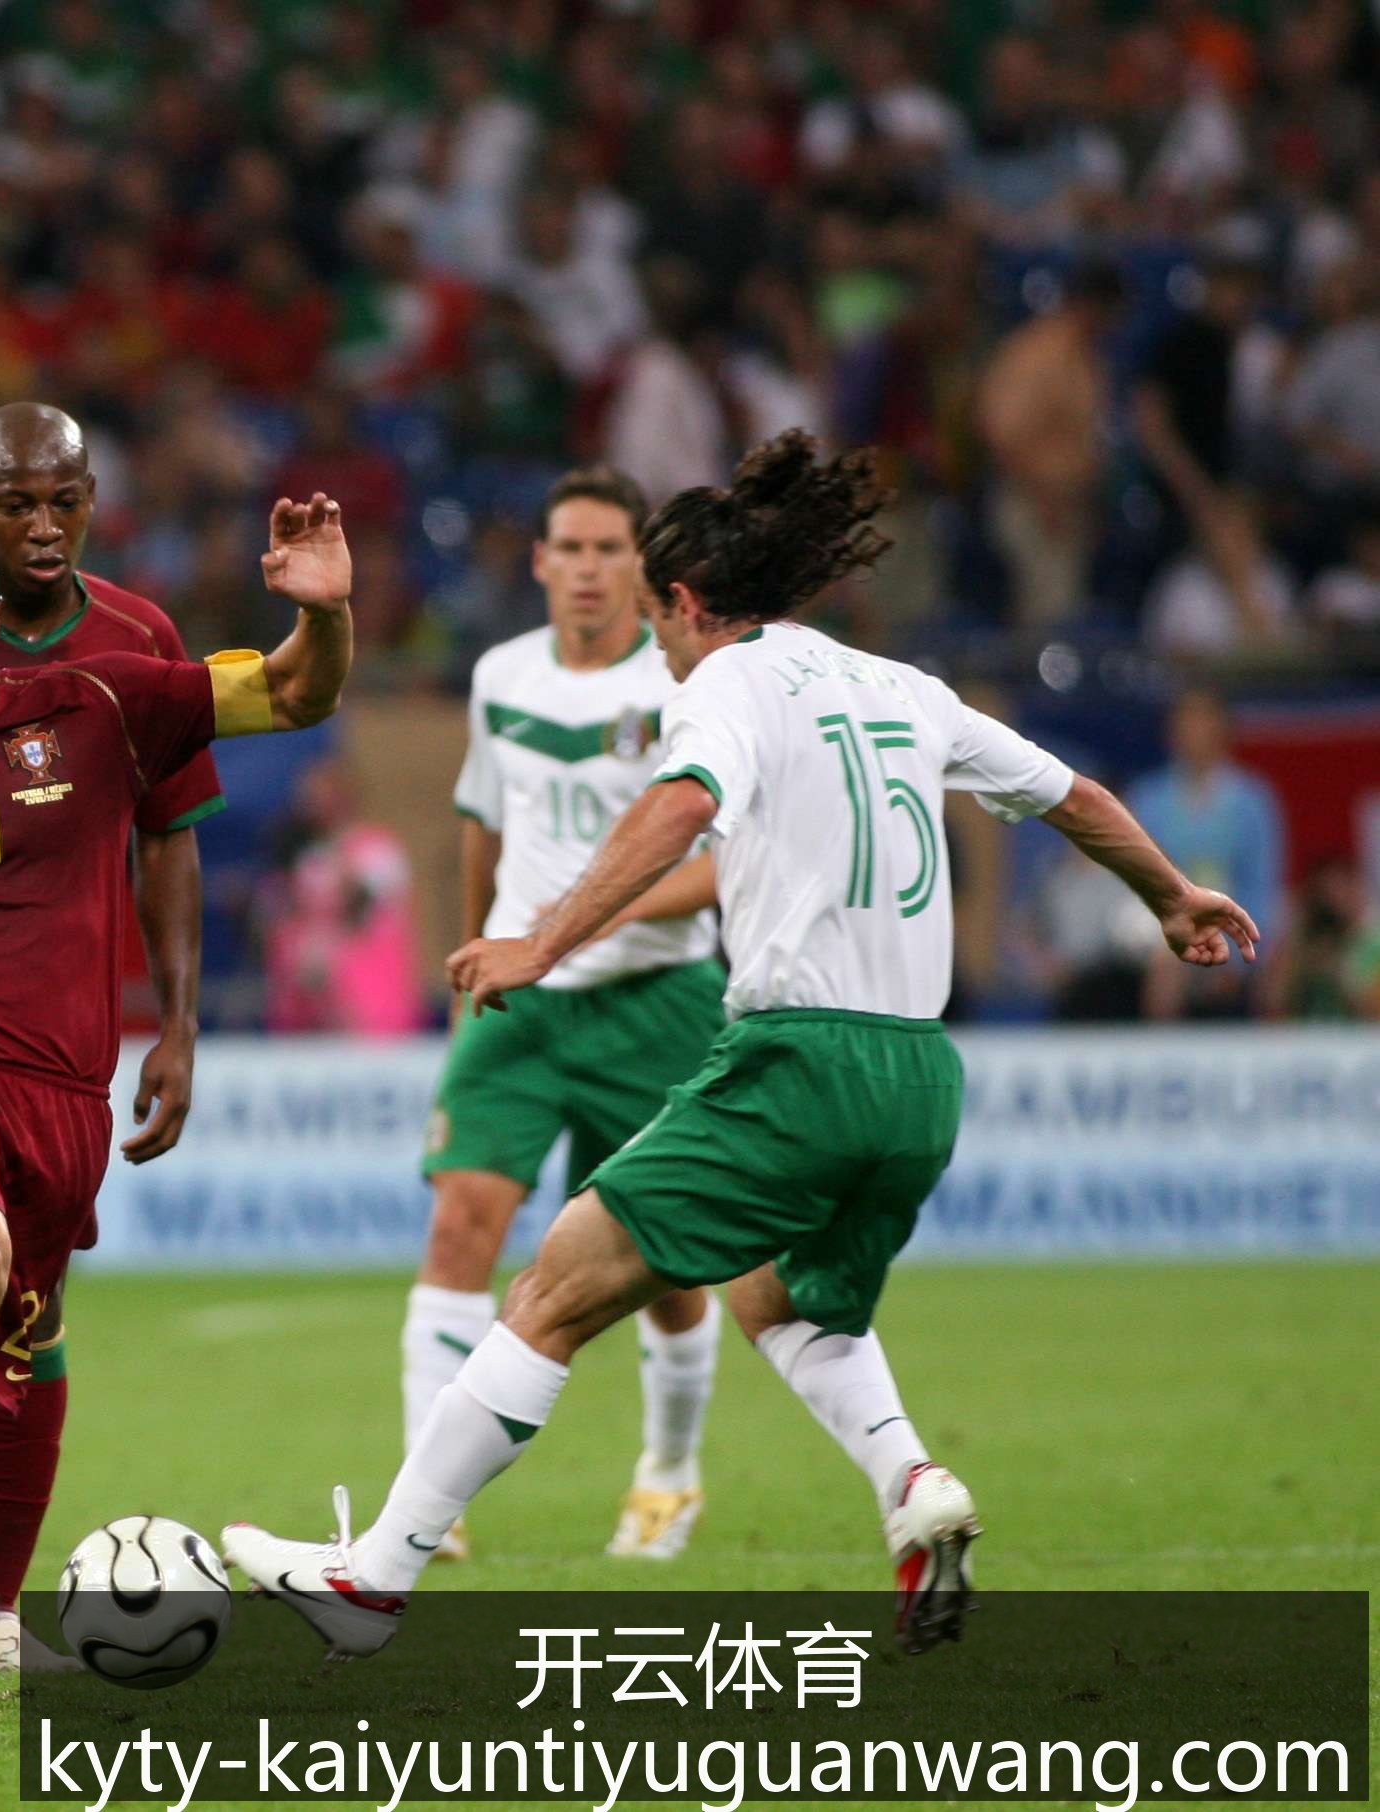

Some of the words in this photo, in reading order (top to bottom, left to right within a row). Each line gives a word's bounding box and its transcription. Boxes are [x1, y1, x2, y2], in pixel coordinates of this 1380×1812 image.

[544, 776, 606, 844] 10
[817, 712, 937, 919] 15
[0, 1290, 47, 1361] 2
